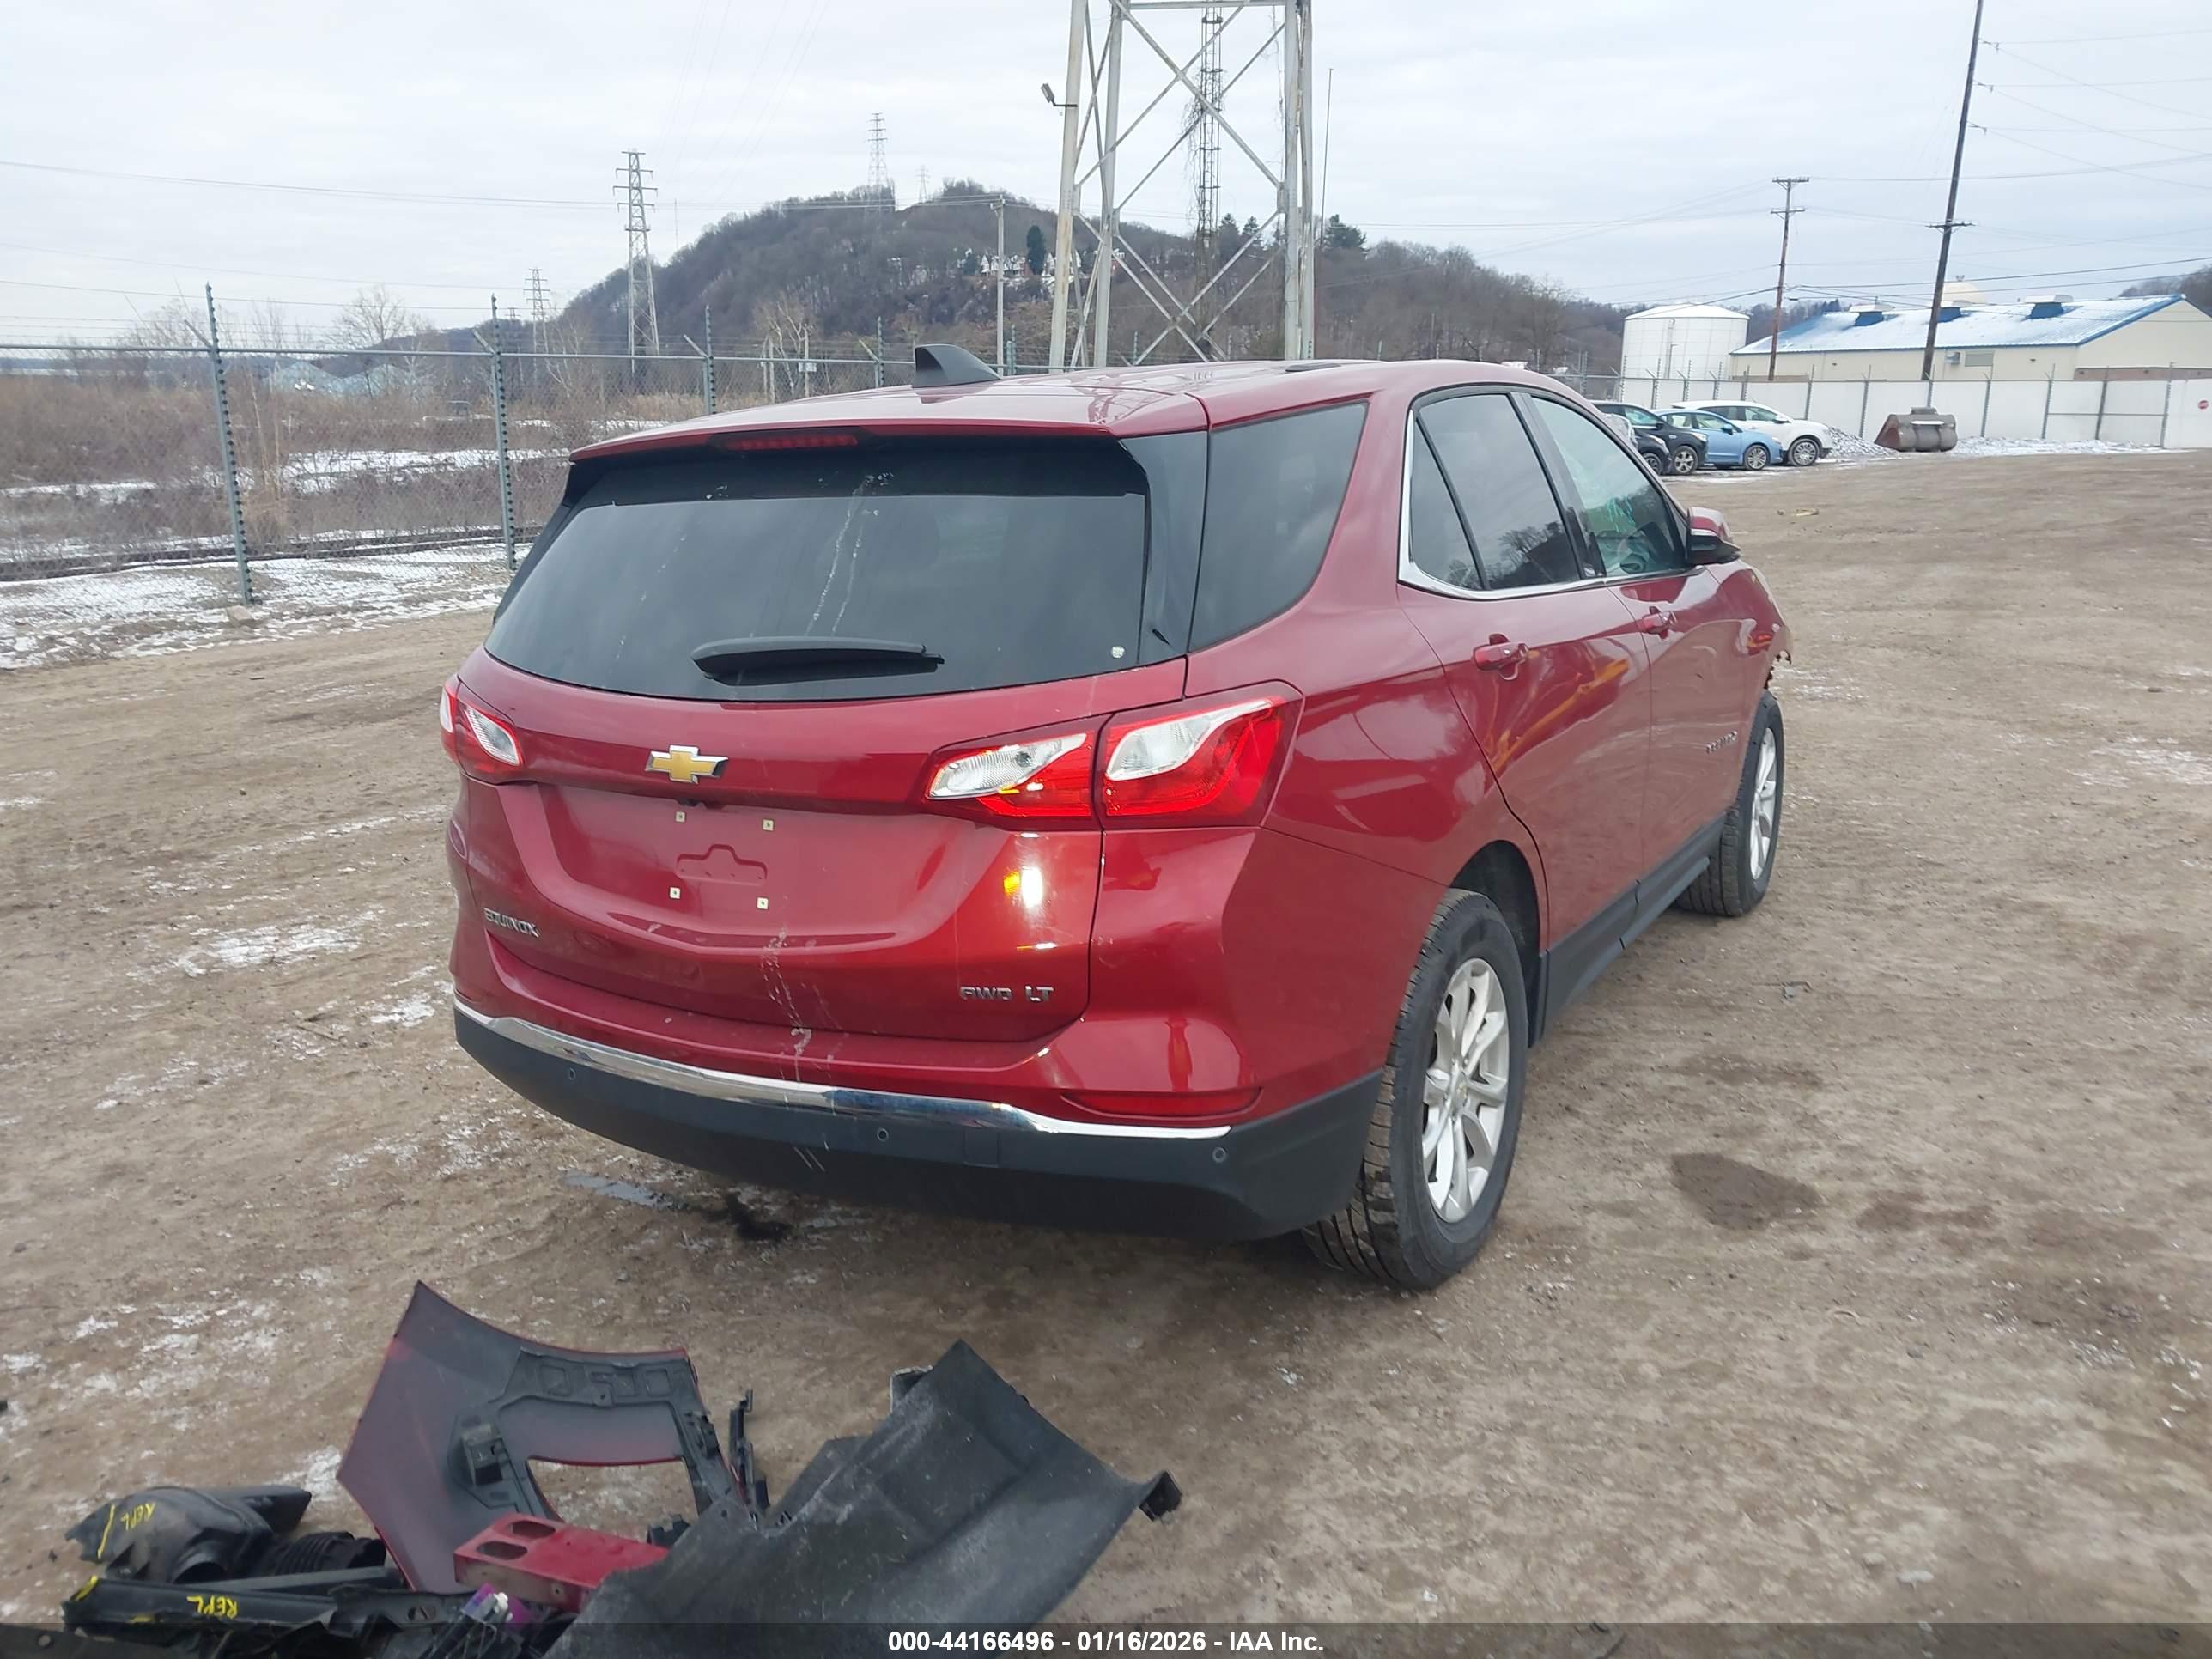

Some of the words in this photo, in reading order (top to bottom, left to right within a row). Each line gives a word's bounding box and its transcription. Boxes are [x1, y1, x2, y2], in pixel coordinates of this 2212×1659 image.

[483, 907, 540, 939] EQUINOX
[1025, 985, 1054, 1001] LT
[186, 1595, 238, 1619] REPL
